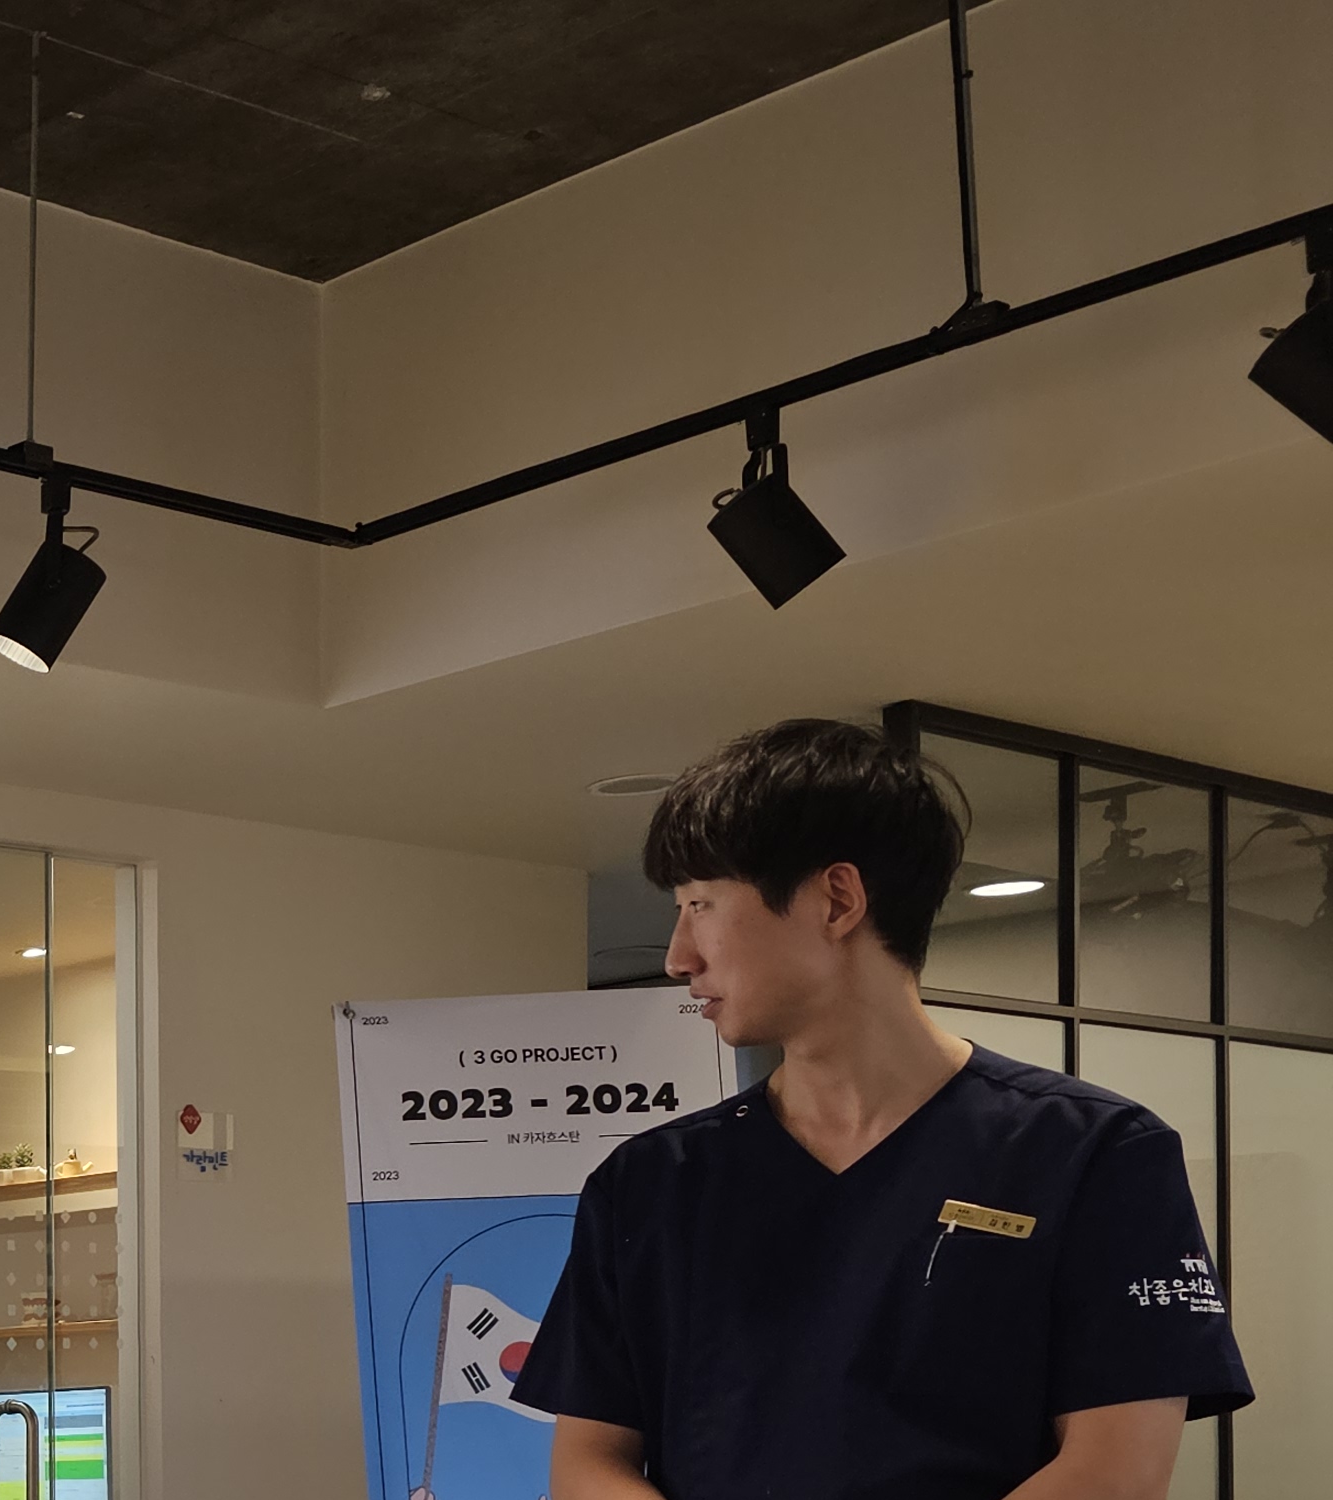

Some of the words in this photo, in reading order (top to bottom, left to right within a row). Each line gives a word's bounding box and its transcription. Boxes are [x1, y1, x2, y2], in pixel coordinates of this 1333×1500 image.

[362, 1016, 389, 1025] 2023
[474, 1051, 485, 1064] 3
[490, 1049, 518, 1063] GO
[522, 1045, 606, 1062] PROJECT
[402, 1087, 513, 1121] 2023
[566, 1082, 679, 1115] 2024
[507, 1133, 521, 1144] IN
[523, 1130, 581, 1144] 카자흐스탄
[372, 1171, 400, 1181] 2023
[1128, 1277, 1216, 1307] 참좋은치과
